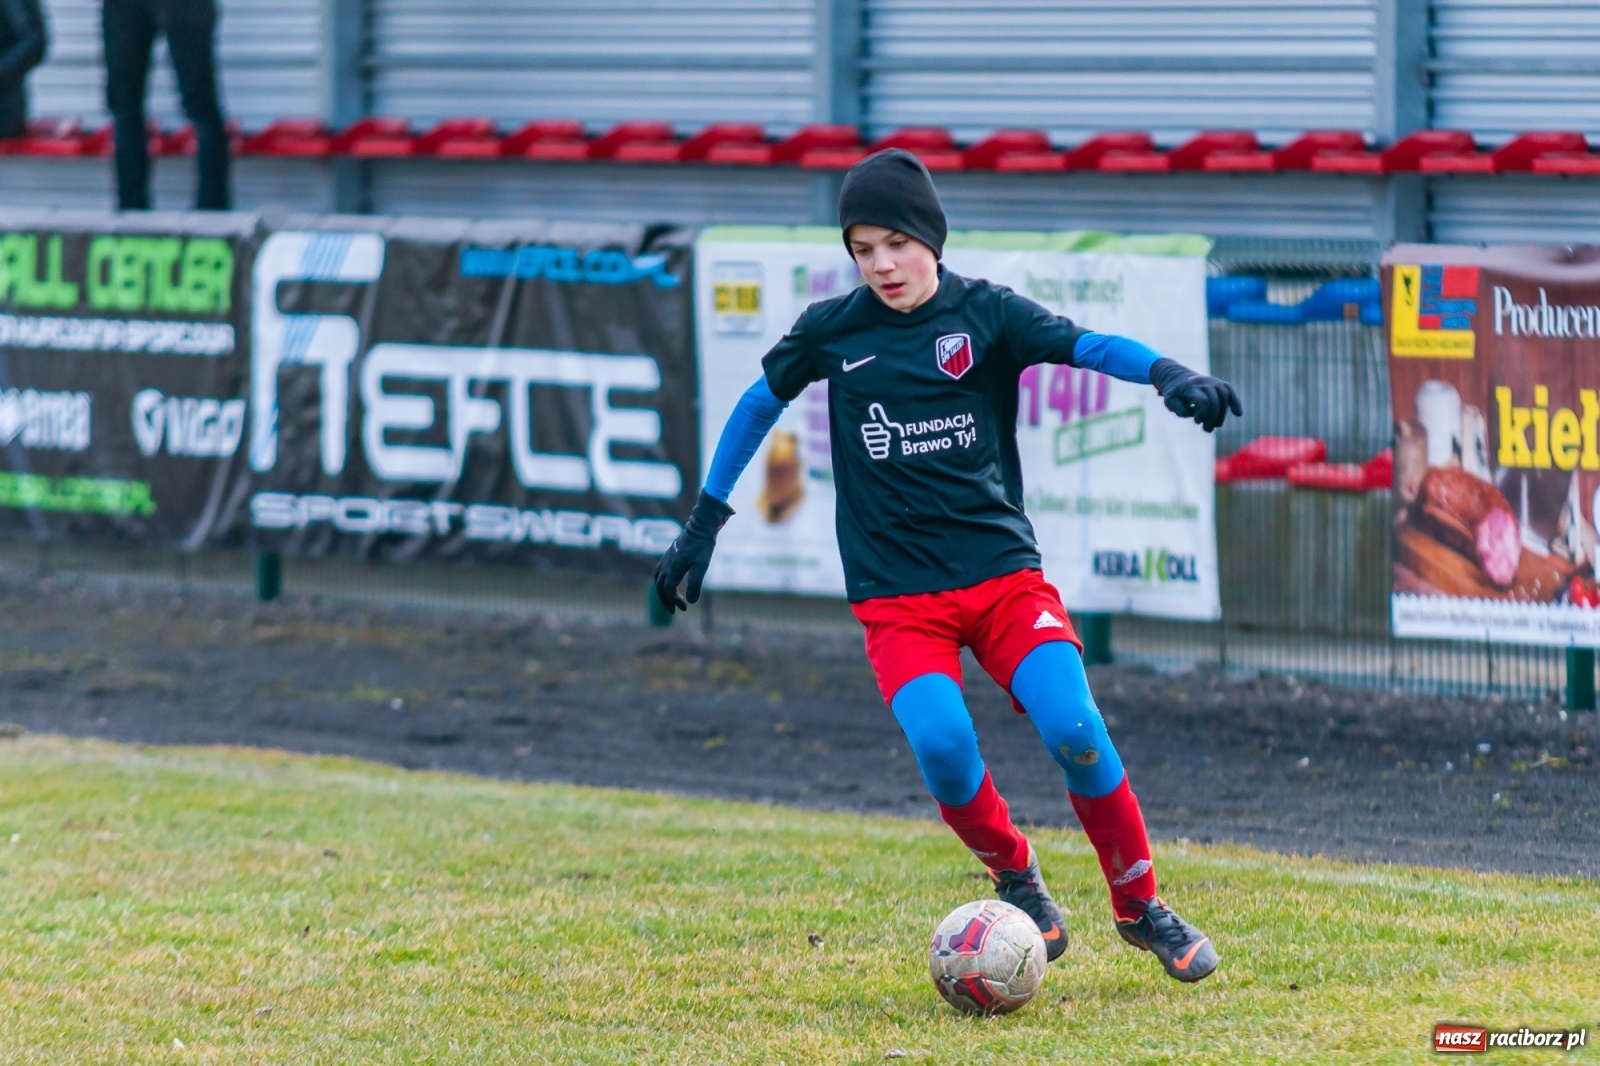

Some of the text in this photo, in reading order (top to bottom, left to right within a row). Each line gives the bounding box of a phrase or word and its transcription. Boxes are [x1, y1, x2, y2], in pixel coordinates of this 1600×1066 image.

[87, 235, 235, 314] CENTER
[901, 427, 977, 456] Brawo Ty!
[905, 412, 974, 436] FUNDACJA
[250, 490, 686, 556] SPORTSWEAR
[1093, 547, 1198, 582] KERAKOLL
